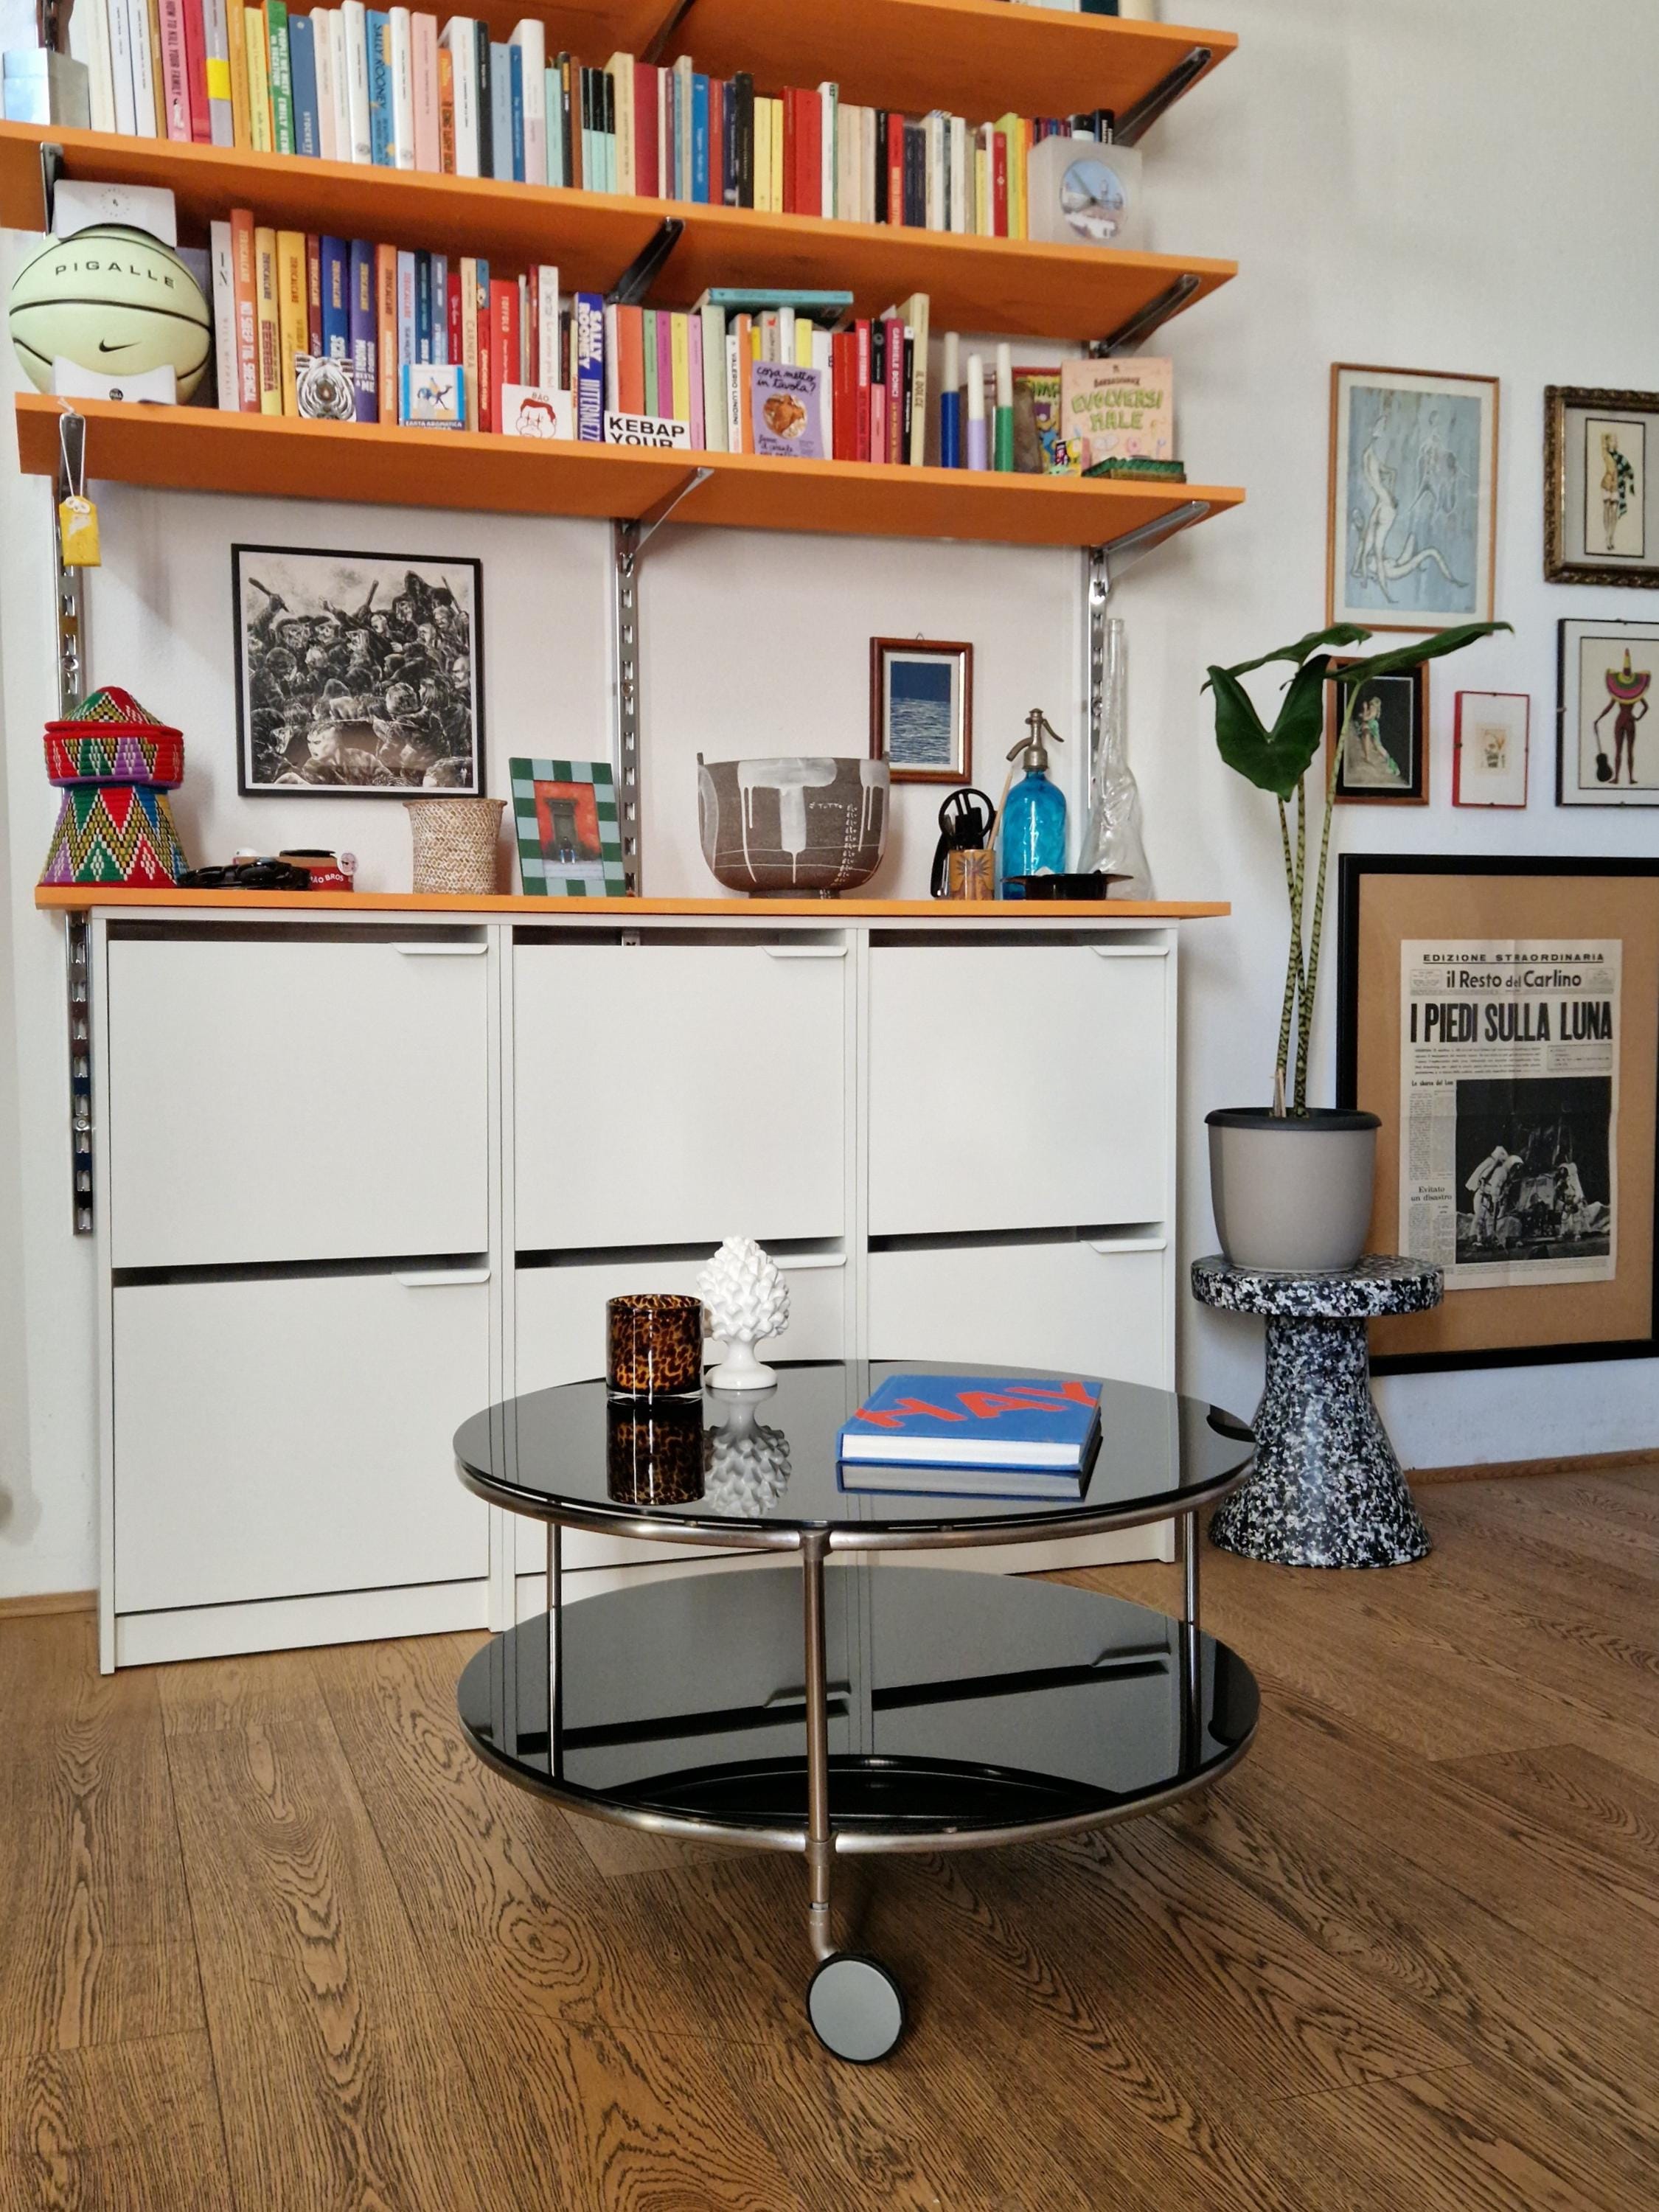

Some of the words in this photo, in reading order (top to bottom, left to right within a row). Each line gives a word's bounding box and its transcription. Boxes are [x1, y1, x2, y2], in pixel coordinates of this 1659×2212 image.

[166, 1, 176, 16] HOW
[167, 20, 177, 29] TO
[167, 31, 178, 46] KILL
[278, 27, 288, 57] PEOPLE
[374, 24, 384, 57] SALLY
[169, 49, 179, 67] YOUR
[171, 70, 181, 96] FAMILY
[375, 60, 386, 108] ROONEY
[278, 98, 288, 127] EMILY
[304, 112, 313, 153] STOCKETT
[55, 260, 175, 289] PIGALLE
[501, 296, 509, 332] TOFFOLO
[465, 320, 475, 369] CARNERA
[579, 302, 590, 370] ROONEY
[591, 311, 601, 362] SALLY
[891, 327, 900, 368] GABRIELE
[757, 366, 782, 378] cosa
[532, 392, 549, 403] BAO
[915, 381, 923, 408] DOLCE
[1071, 389, 1163, 414] EVOLVERSI
[610, 417, 684, 437] KEBAP
[1090, 410, 1144, 432] MALE
[611, 434, 673, 448] YOUR
[325, 873, 344, 882] BROS
[1496, 953, 1604, 961] STRAORDINARIA
[1447, 970, 1455, 988] il
[1460, 970, 1502, 988] Resto
[1506, 975, 1521, 987] del
[1524, 970, 1582, 987] Carlino
[1411, 1004, 1417, 1043] I
[1425, 1003, 1478, 1043] PIEDI
[1485, 1002, 1550, 1042] SULLA
[1560, 1001, 1613, 1041] LUNA
